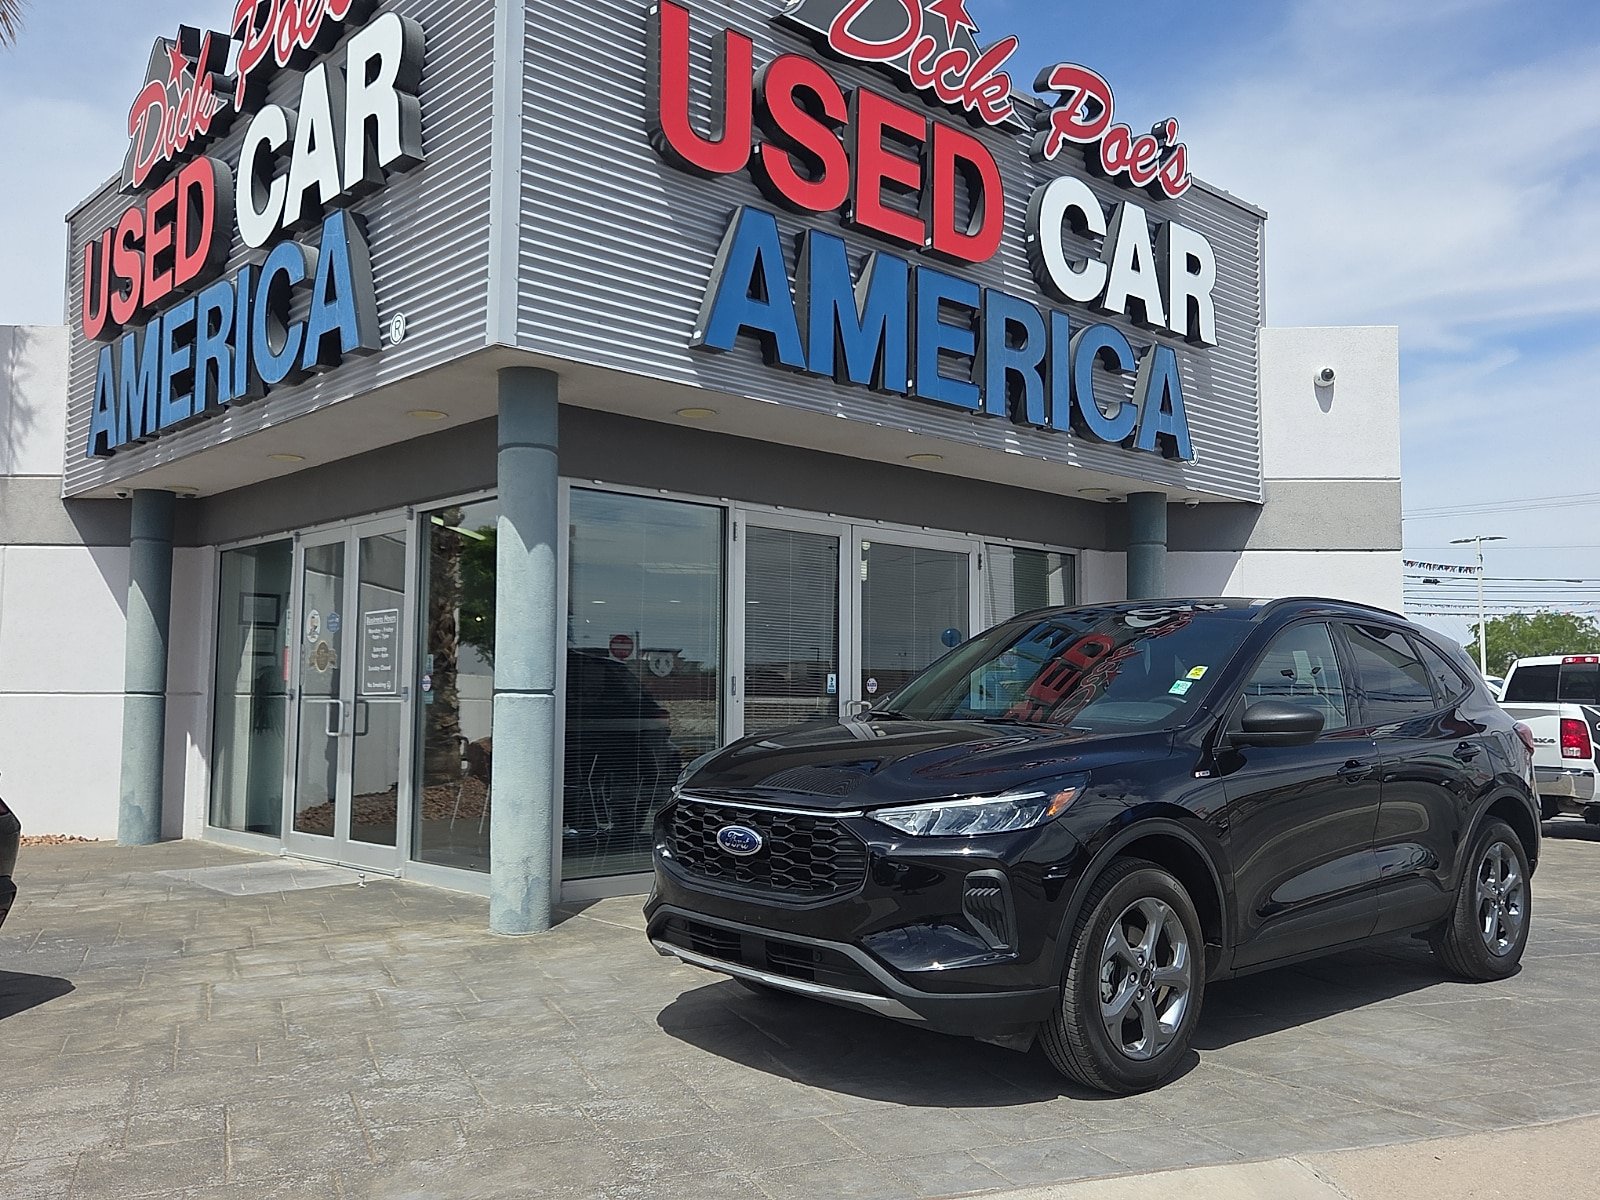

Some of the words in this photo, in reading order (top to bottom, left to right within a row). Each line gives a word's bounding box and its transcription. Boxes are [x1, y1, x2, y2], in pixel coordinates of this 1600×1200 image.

[82, 156, 215, 340] USED
[236, 12, 403, 249] CAR
[128, 30, 219, 188] Dick
[660, 1, 1004, 263] USED
[1038, 176, 1218, 346] CAR
[1047, 63, 1192, 199] Poe's
[86, 209, 359, 458] AMERICA
[704, 206, 1193, 461] AMERICA
[724, 830, 751, 850] Ford
